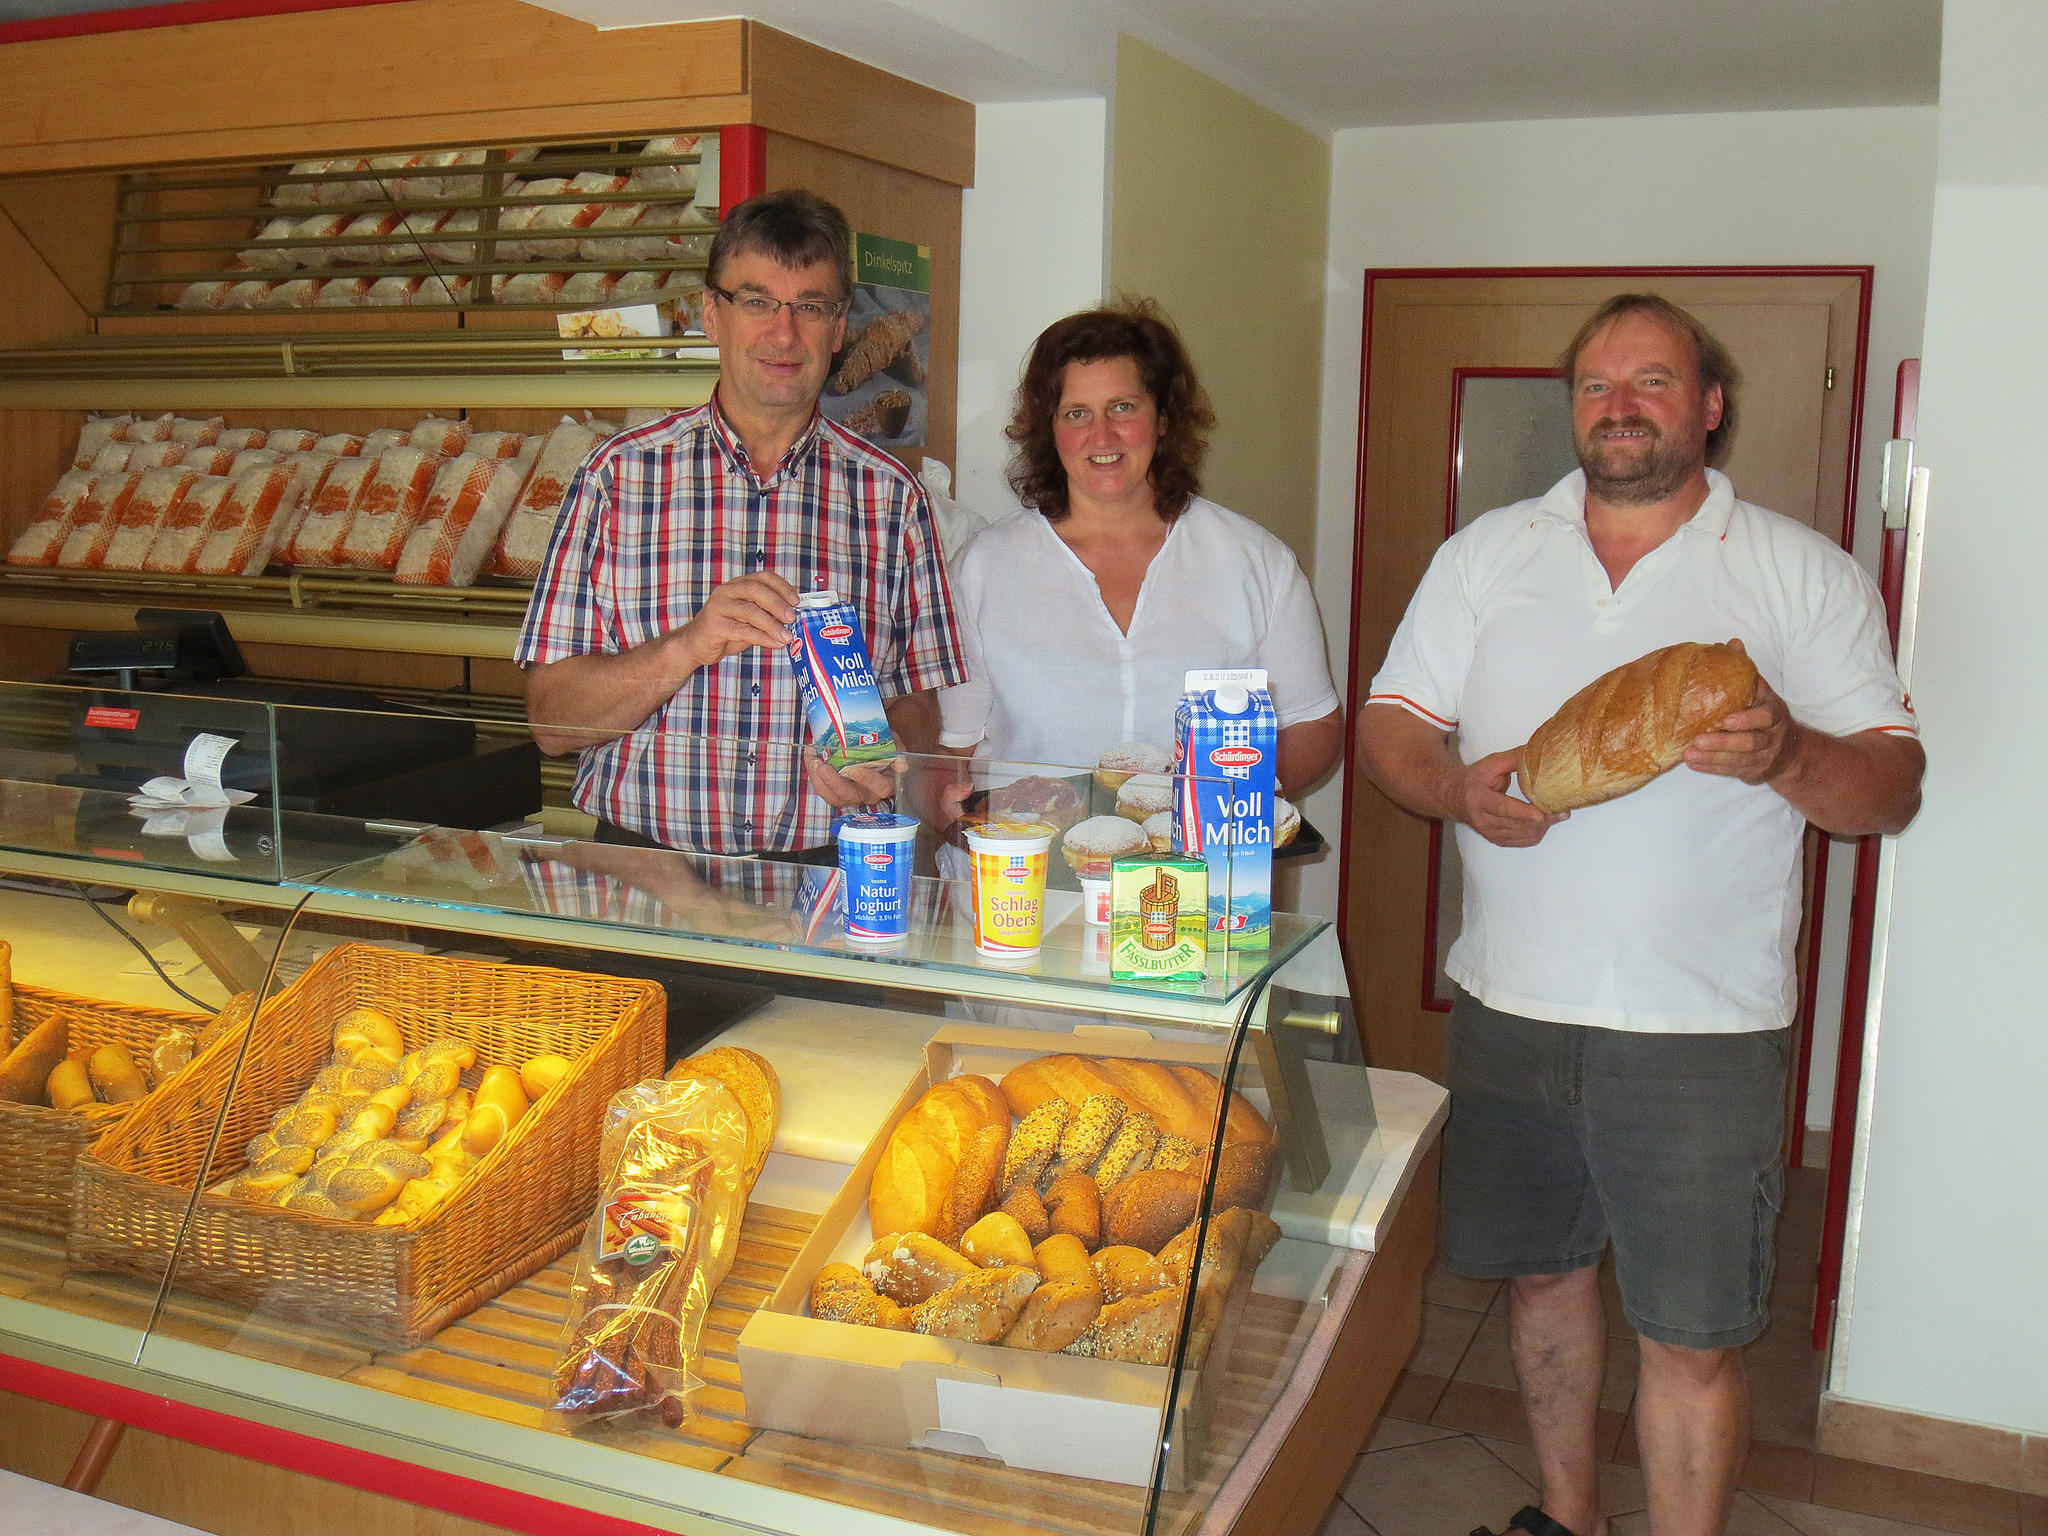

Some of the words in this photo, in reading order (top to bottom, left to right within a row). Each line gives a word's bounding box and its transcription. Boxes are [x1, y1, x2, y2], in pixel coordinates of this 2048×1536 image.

[865, 250, 913, 277] Dinkelspitz
[832, 652, 865, 671] Voll
[831, 670, 876, 690] Milch
[1213, 751, 1260, 763] Schärdinger
[1216, 791, 1262, 818] Voll
[1206, 819, 1270, 846] Milch
[860, 884, 898, 898] Natur
[854, 898, 902, 915] Joghurt
[990, 897, 1039, 914] Schlag
[992, 913, 1037, 928] Obers
[1119, 940, 1197, 971] FASSLBUTTER
